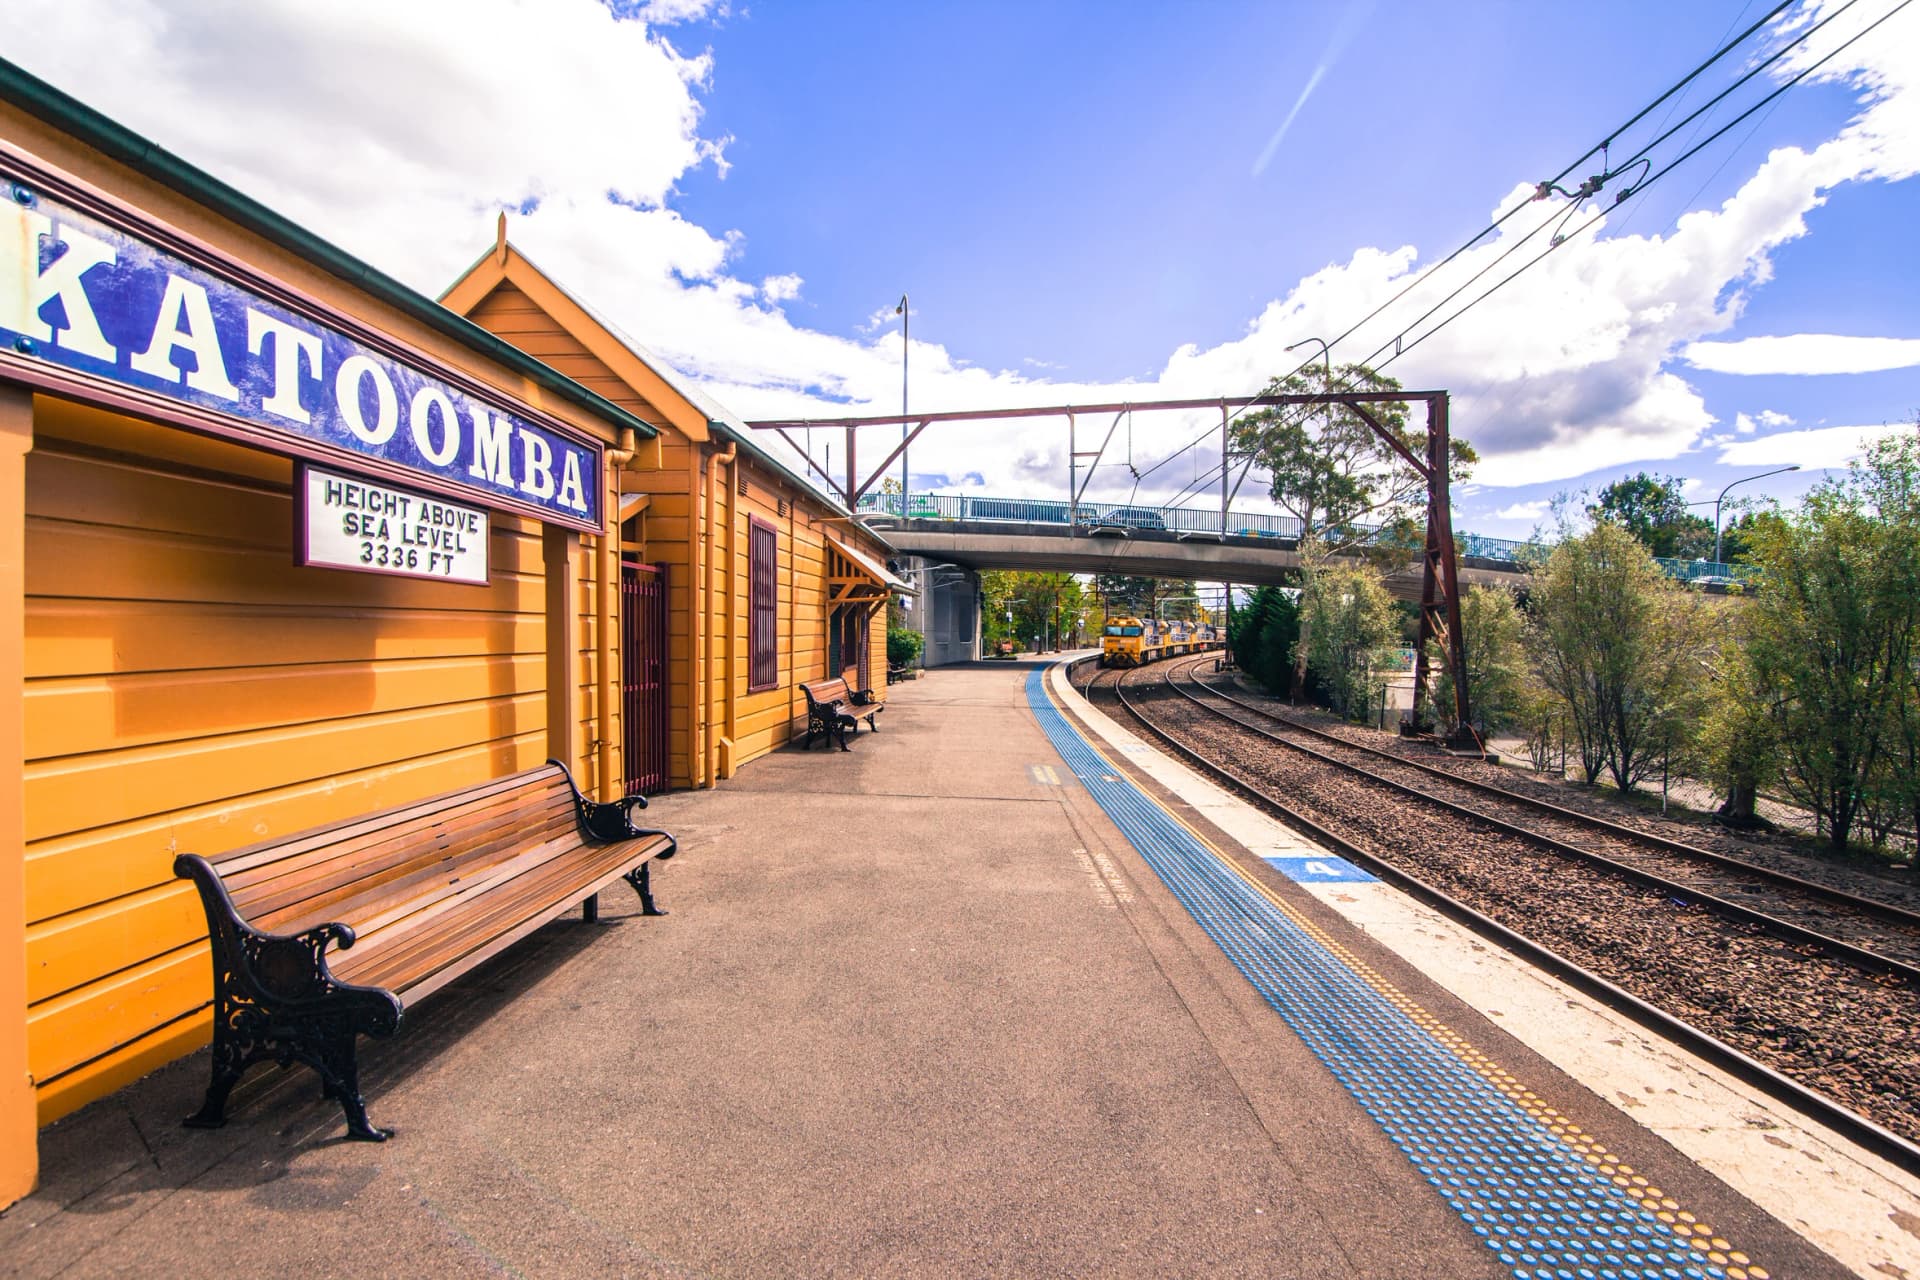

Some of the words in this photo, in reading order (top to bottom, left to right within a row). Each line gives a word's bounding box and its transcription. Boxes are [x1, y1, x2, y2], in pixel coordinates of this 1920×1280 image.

[0, 196, 587, 512] KATOOMBA
[325, 480, 411, 519] HEIGHT
[419, 503, 478, 533] ABOVE
[343, 513, 390, 541] SEA
[402, 523, 467, 552] LEVEL
[360, 541, 418, 569] 3336
[428, 552, 455, 575] FT
